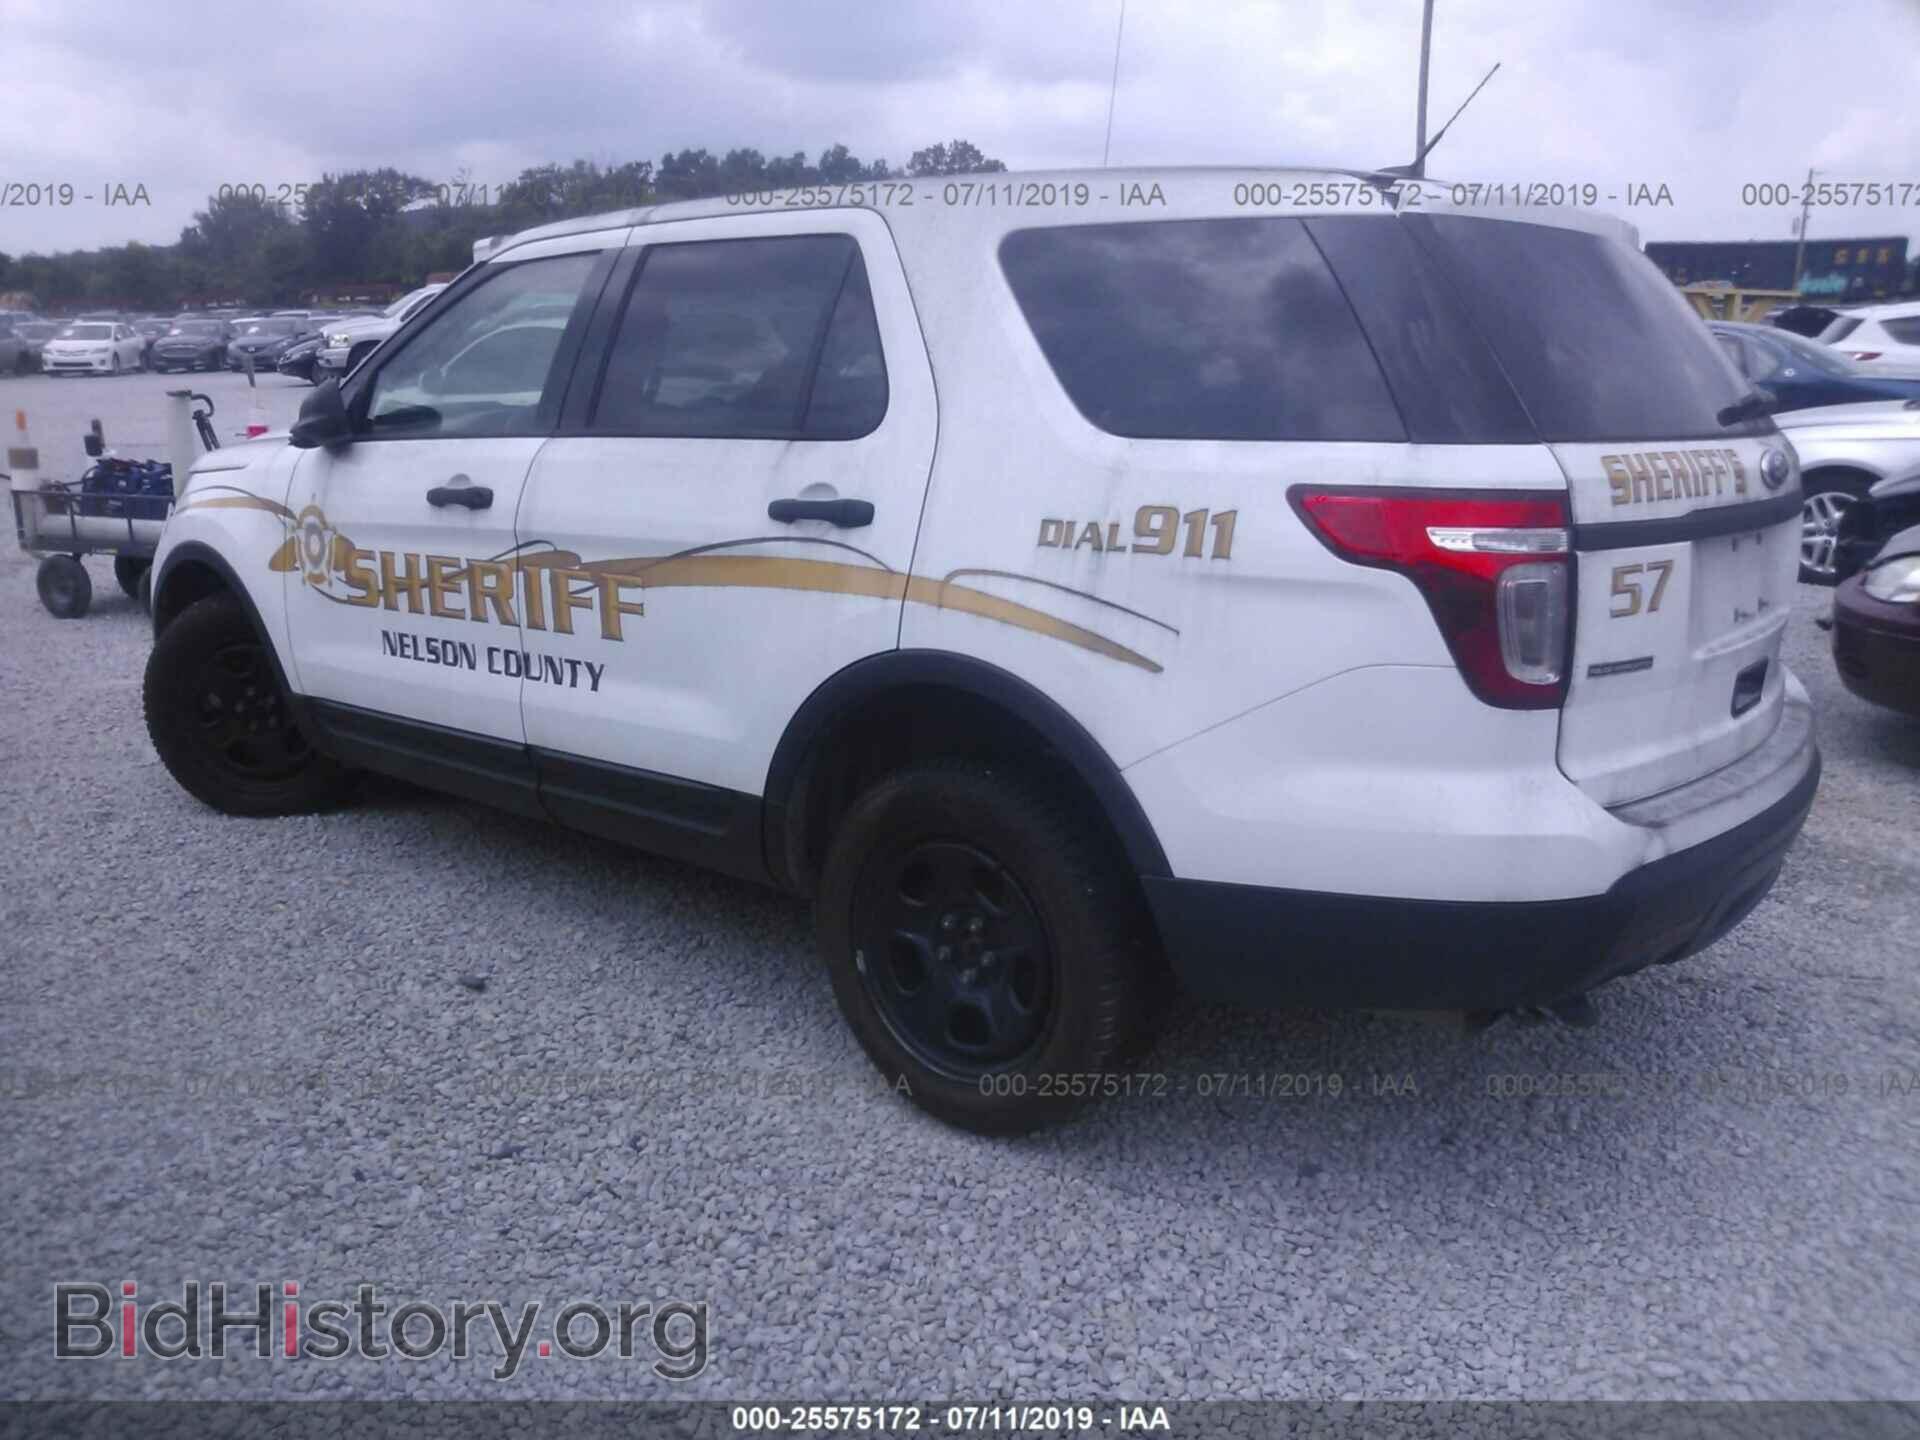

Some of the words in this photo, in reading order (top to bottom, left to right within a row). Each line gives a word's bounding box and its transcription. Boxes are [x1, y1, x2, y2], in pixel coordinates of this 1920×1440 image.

[1600, 449, 1747, 506] SHERIFF'S
[345, 548, 644, 641] SHERIFF
[1609, 559, 1675, 618] 57
[380, 629, 478, 671] NELSON
[486, 646, 605, 692] COUNTY
